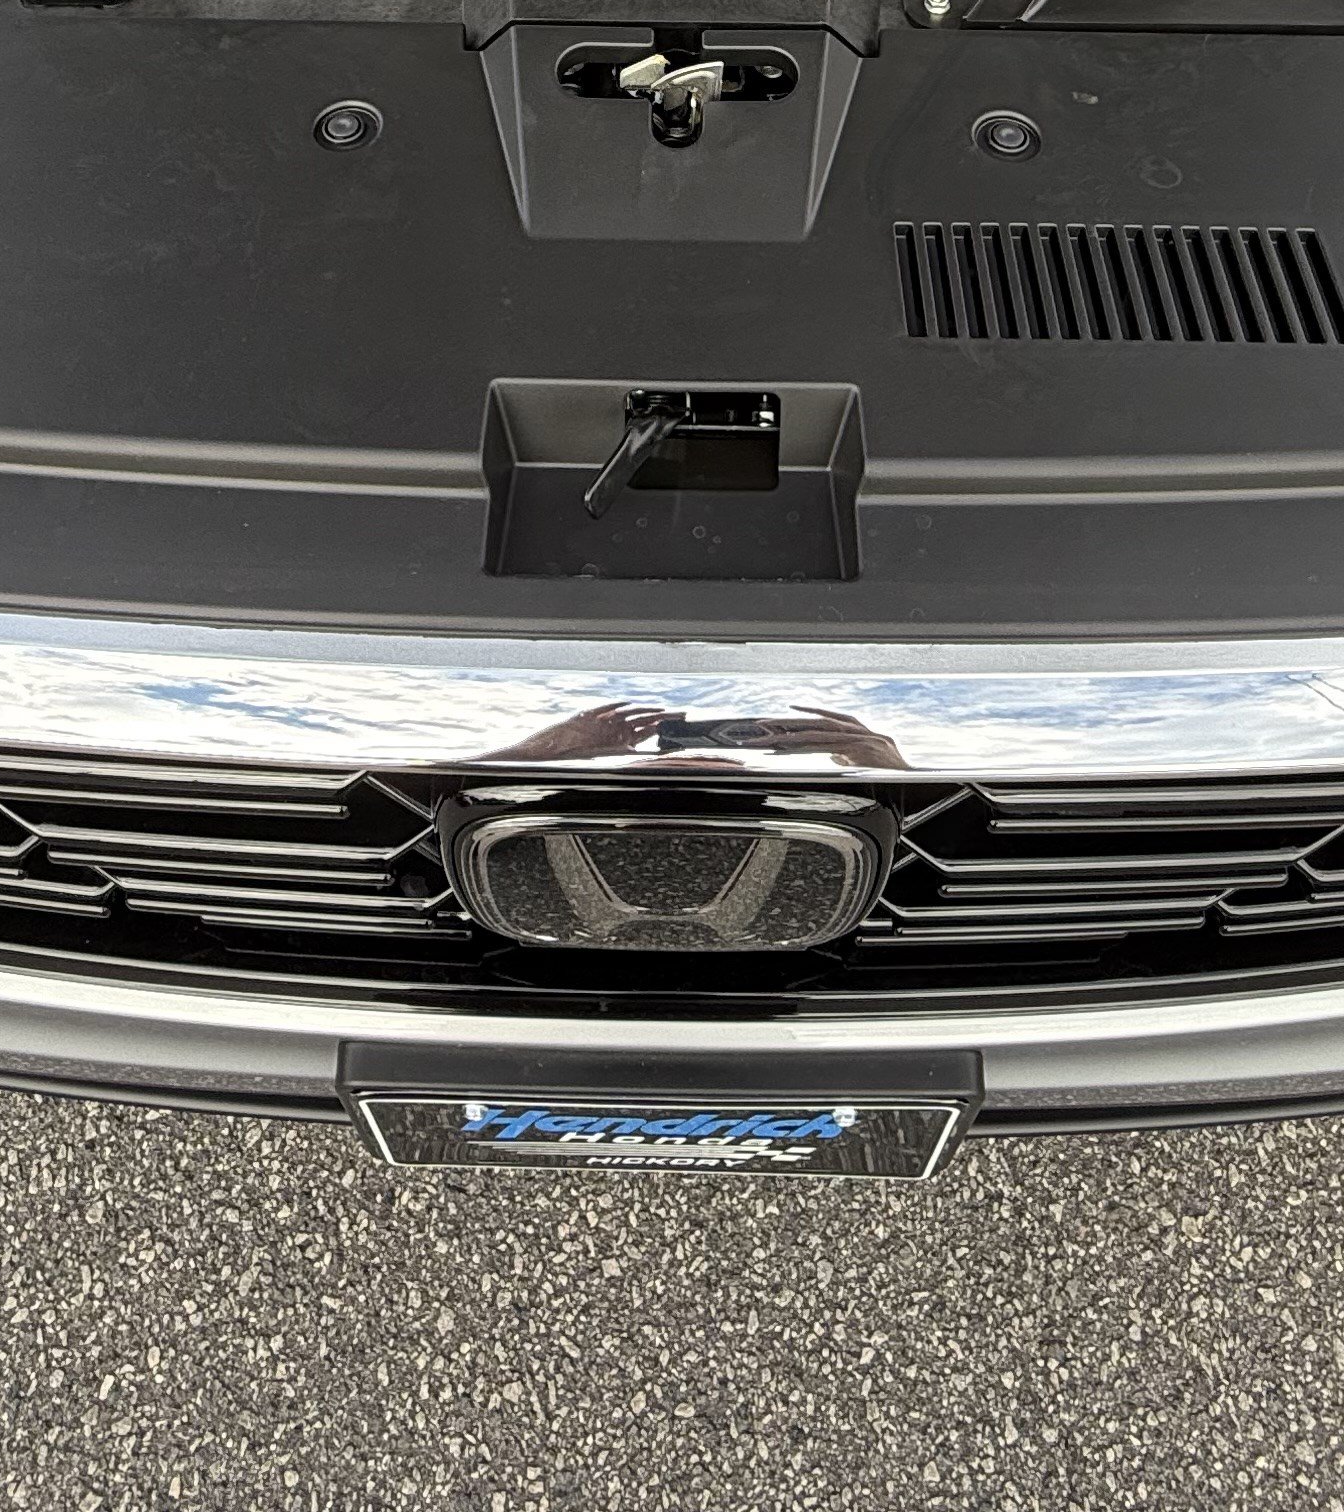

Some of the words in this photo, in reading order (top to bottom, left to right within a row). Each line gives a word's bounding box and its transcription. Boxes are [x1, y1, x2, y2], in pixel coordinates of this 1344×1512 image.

[462, 1109, 843, 1139] Hendrick
[558, 1132, 773, 1147] Honda
[586, 1157, 746, 1168] HICKORY
